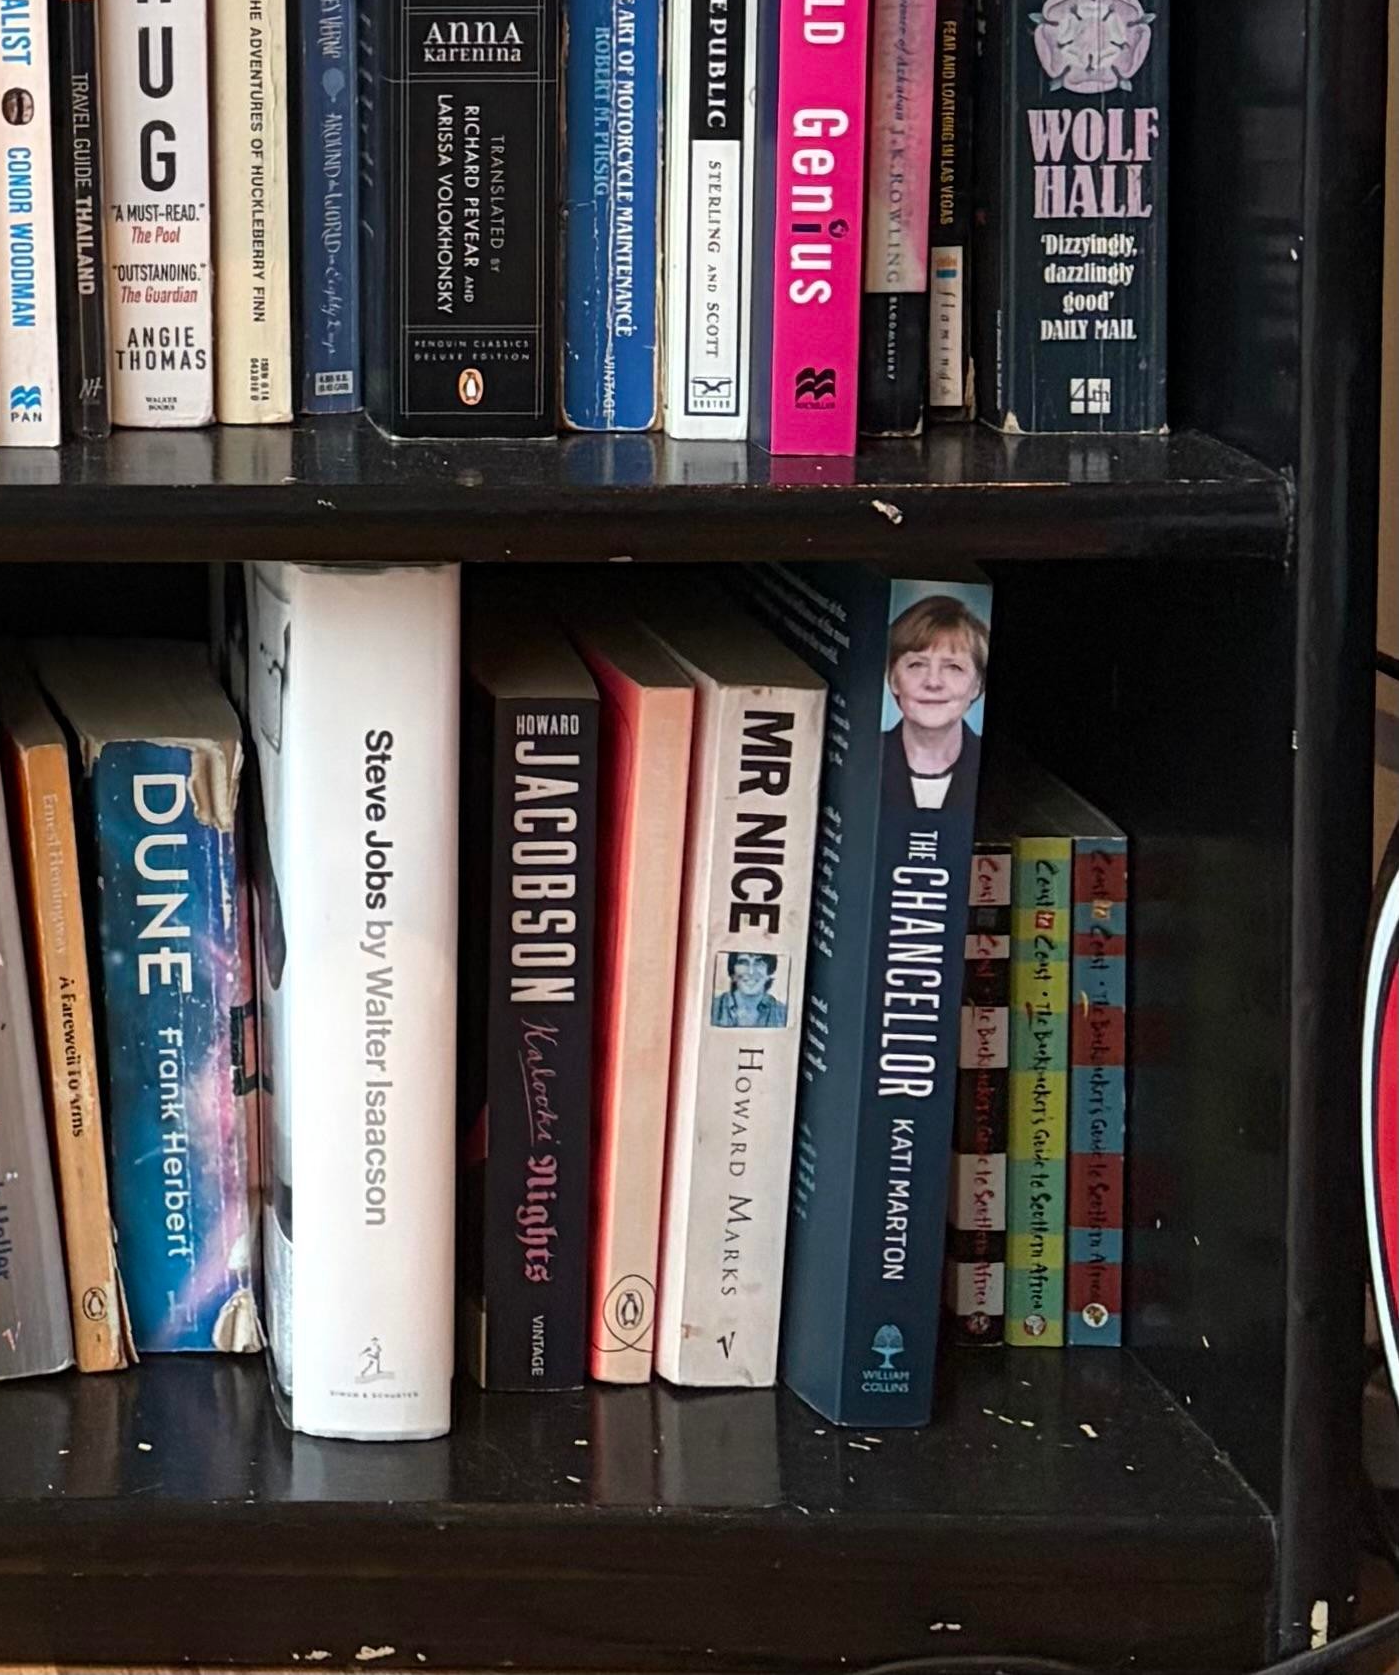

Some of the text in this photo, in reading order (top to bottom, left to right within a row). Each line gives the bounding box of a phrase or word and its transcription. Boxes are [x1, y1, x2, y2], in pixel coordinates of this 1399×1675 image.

[1027, 108, 1159, 163] WOLF
[1034, 165, 1152, 218] HALL
[7, 147, 35, 327] CONOR WOODMAN
[437, 174, 453, 314] VOLOKHONSKY
[144, 288, 197, 304] Guardian
[128, 327, 195, 347] ANGIE
[1041, 319, 1136, 341] DAILY MAIL
[116, 350, 207, 371] THOMAS
[516, 714, 579, 736] HOWARD
[728, 710, 796, 935] MR NICE
[133, 774, 193, 995] DUNE
[510, 741, 580, 1003] JACOBSON
[359, 730, 394, 1227] Steve Jobs by Walter Isaacson
[877, 866, 949, 1097] CHANCELLOR
[883, 1119, 915, 1281] KATI MARTON
[531, 1316, 544, 1376] VINTAGE
[862, 1383, 908, 1393] COLLINS
